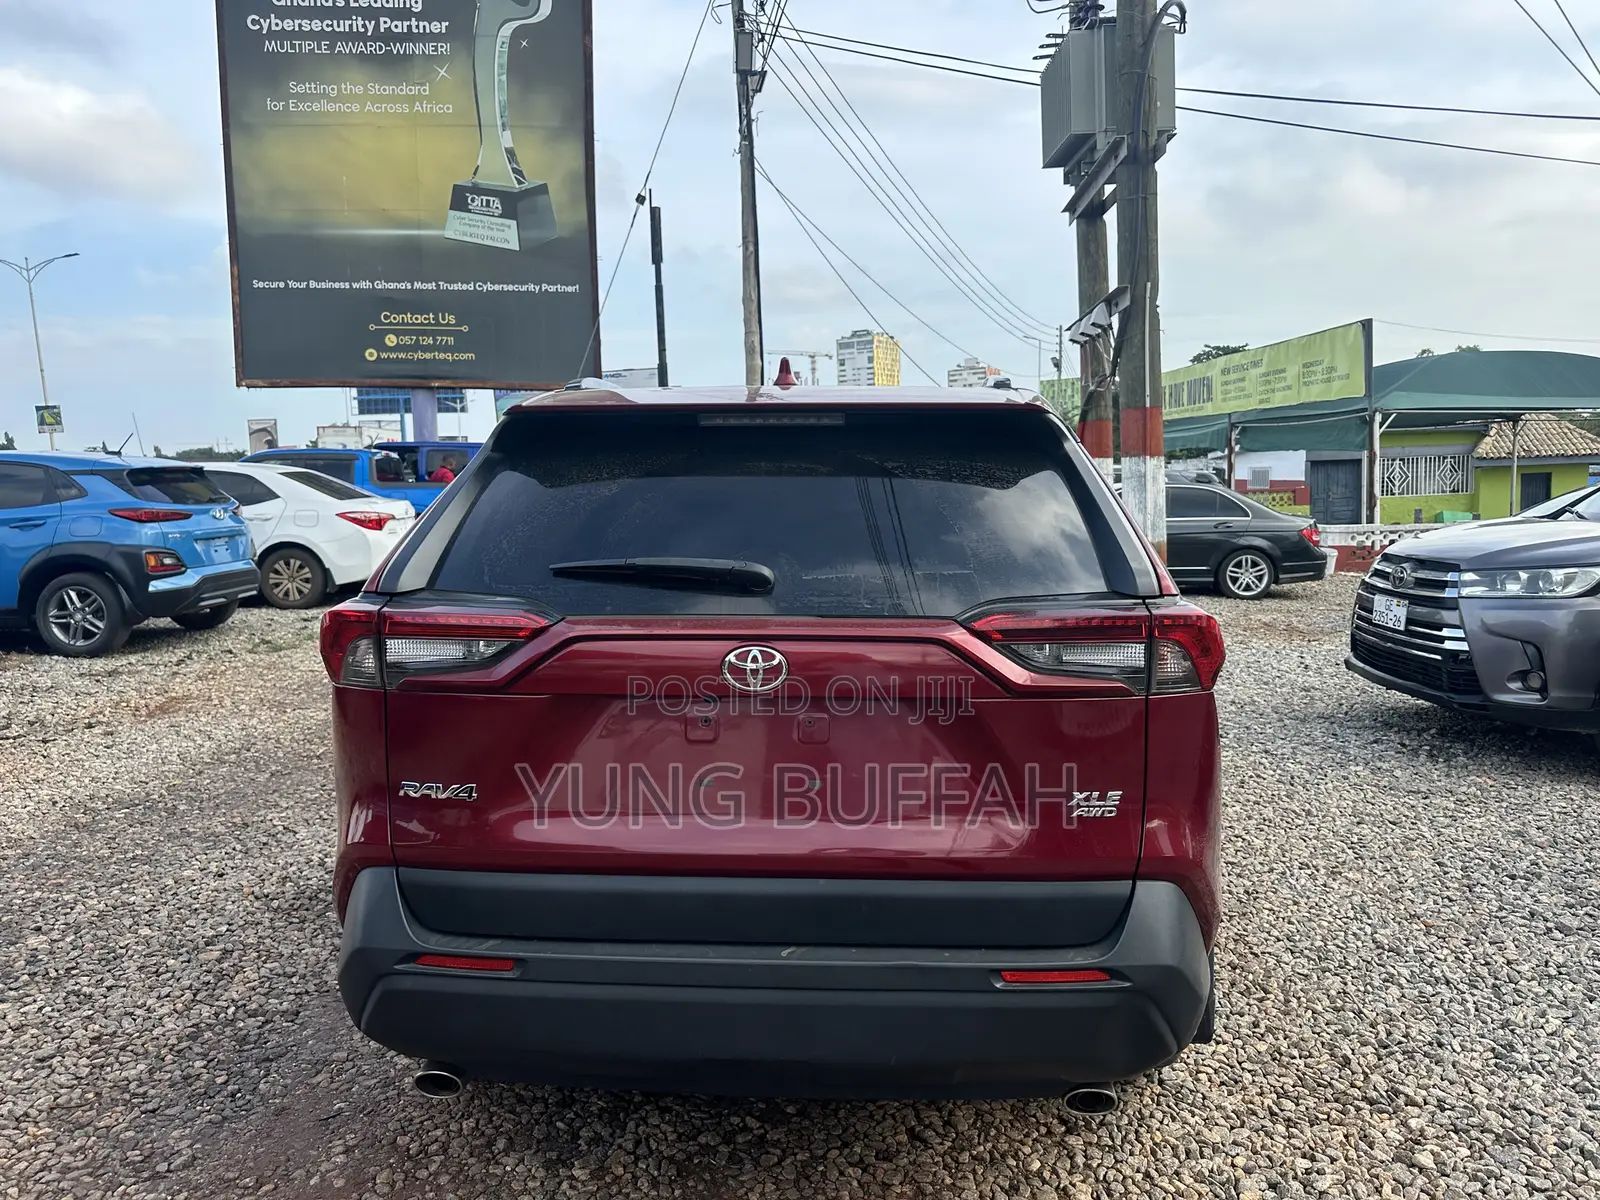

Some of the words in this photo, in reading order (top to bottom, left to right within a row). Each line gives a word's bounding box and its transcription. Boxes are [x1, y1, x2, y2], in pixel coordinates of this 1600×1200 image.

[246, 13, 376, 36] Cybersecurity
[379, 16, 450, 34] Partner
[263, 40, 331, 54] MULTIPLE
[334, 41, 450, 55] AWARD-WINNER!
[289, 81, 338, 97] Setting
[341, 82, 364, 94] the
[367, 82, 430, 95] Standard
[266, 98, 285, 111] for
[289, 99, 360, 113] Excellence
[364, 101, 409, 113] Across
[413, 101, 453, 114] Africa
[252, 279, 285, 289] Secure
[287, 279, 308, 289] Your
[309, 280, 350, 289] Business
[351, 280, 373, 289] with
[374, 280, 412, 290] Ghana's
[413, 281, 437, 290] Most
[438, 281, 474, 291] Trusted
[475, 282, 541, 294] Cybersecurity
[541, 283, 580, 293] Partner!
[380, 311, 436, 324] Contact
[438, 312, 456, 324] Us
[398, 336, 416, 345] 057
[418, 336, 434, 345] 124
[436, 336, 454, 346] 7711
[379, 350, 476, 362] www.cyberteq.com
[1384, 598, 1394, 612] GE
[1373, 609, 1402, 628] 2351-26
[398, 781, 478, 802] RAV4
[1067, 791, 1123, 806] XLE
[1070, 807, 1118, 818] AWD
